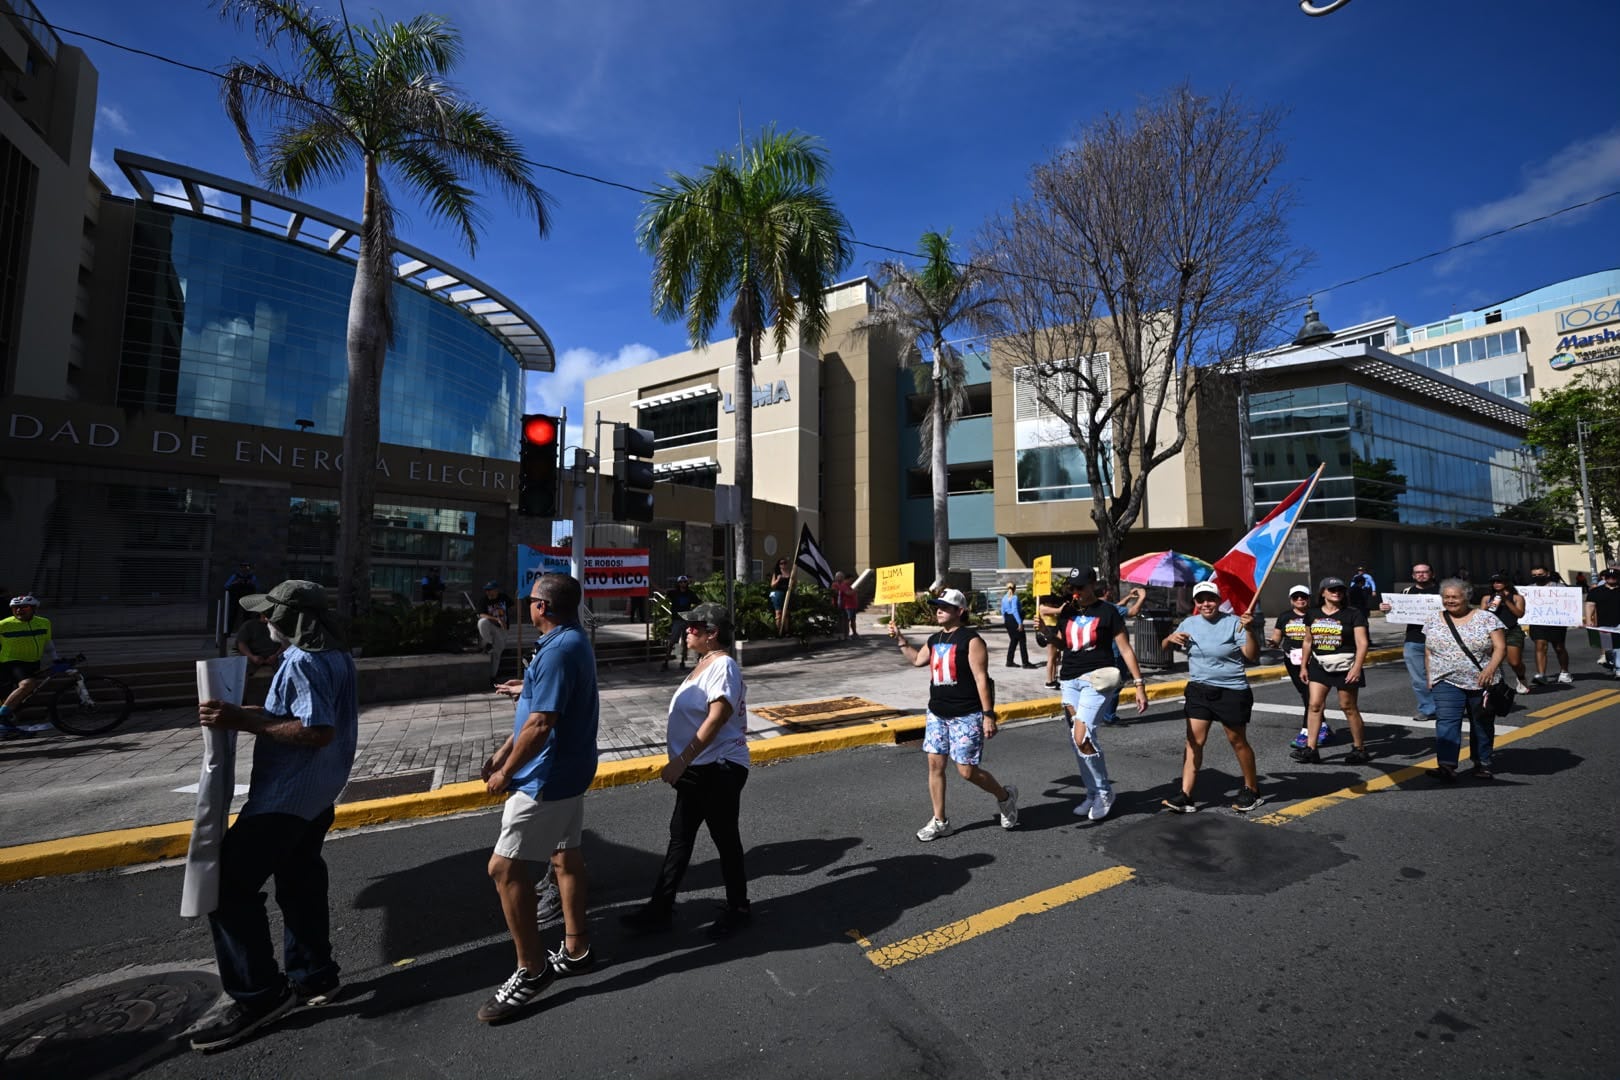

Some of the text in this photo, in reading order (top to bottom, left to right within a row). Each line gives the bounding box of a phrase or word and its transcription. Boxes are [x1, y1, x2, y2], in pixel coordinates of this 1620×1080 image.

[1560, 299, 1620, 330] 1064
[722, 379, 791, 414] LMA
[8, 413, 515, 491] DAD DE ENERA ELECTRI
[544, 558, 570, 568] BASTA
[594, 559, 624, 568] ROBOS!
[611, 571, 647, 587] RICO,
[882, 567, 903, 579] LUMA
[1310, 627, 1342, 635] UNIDOS
